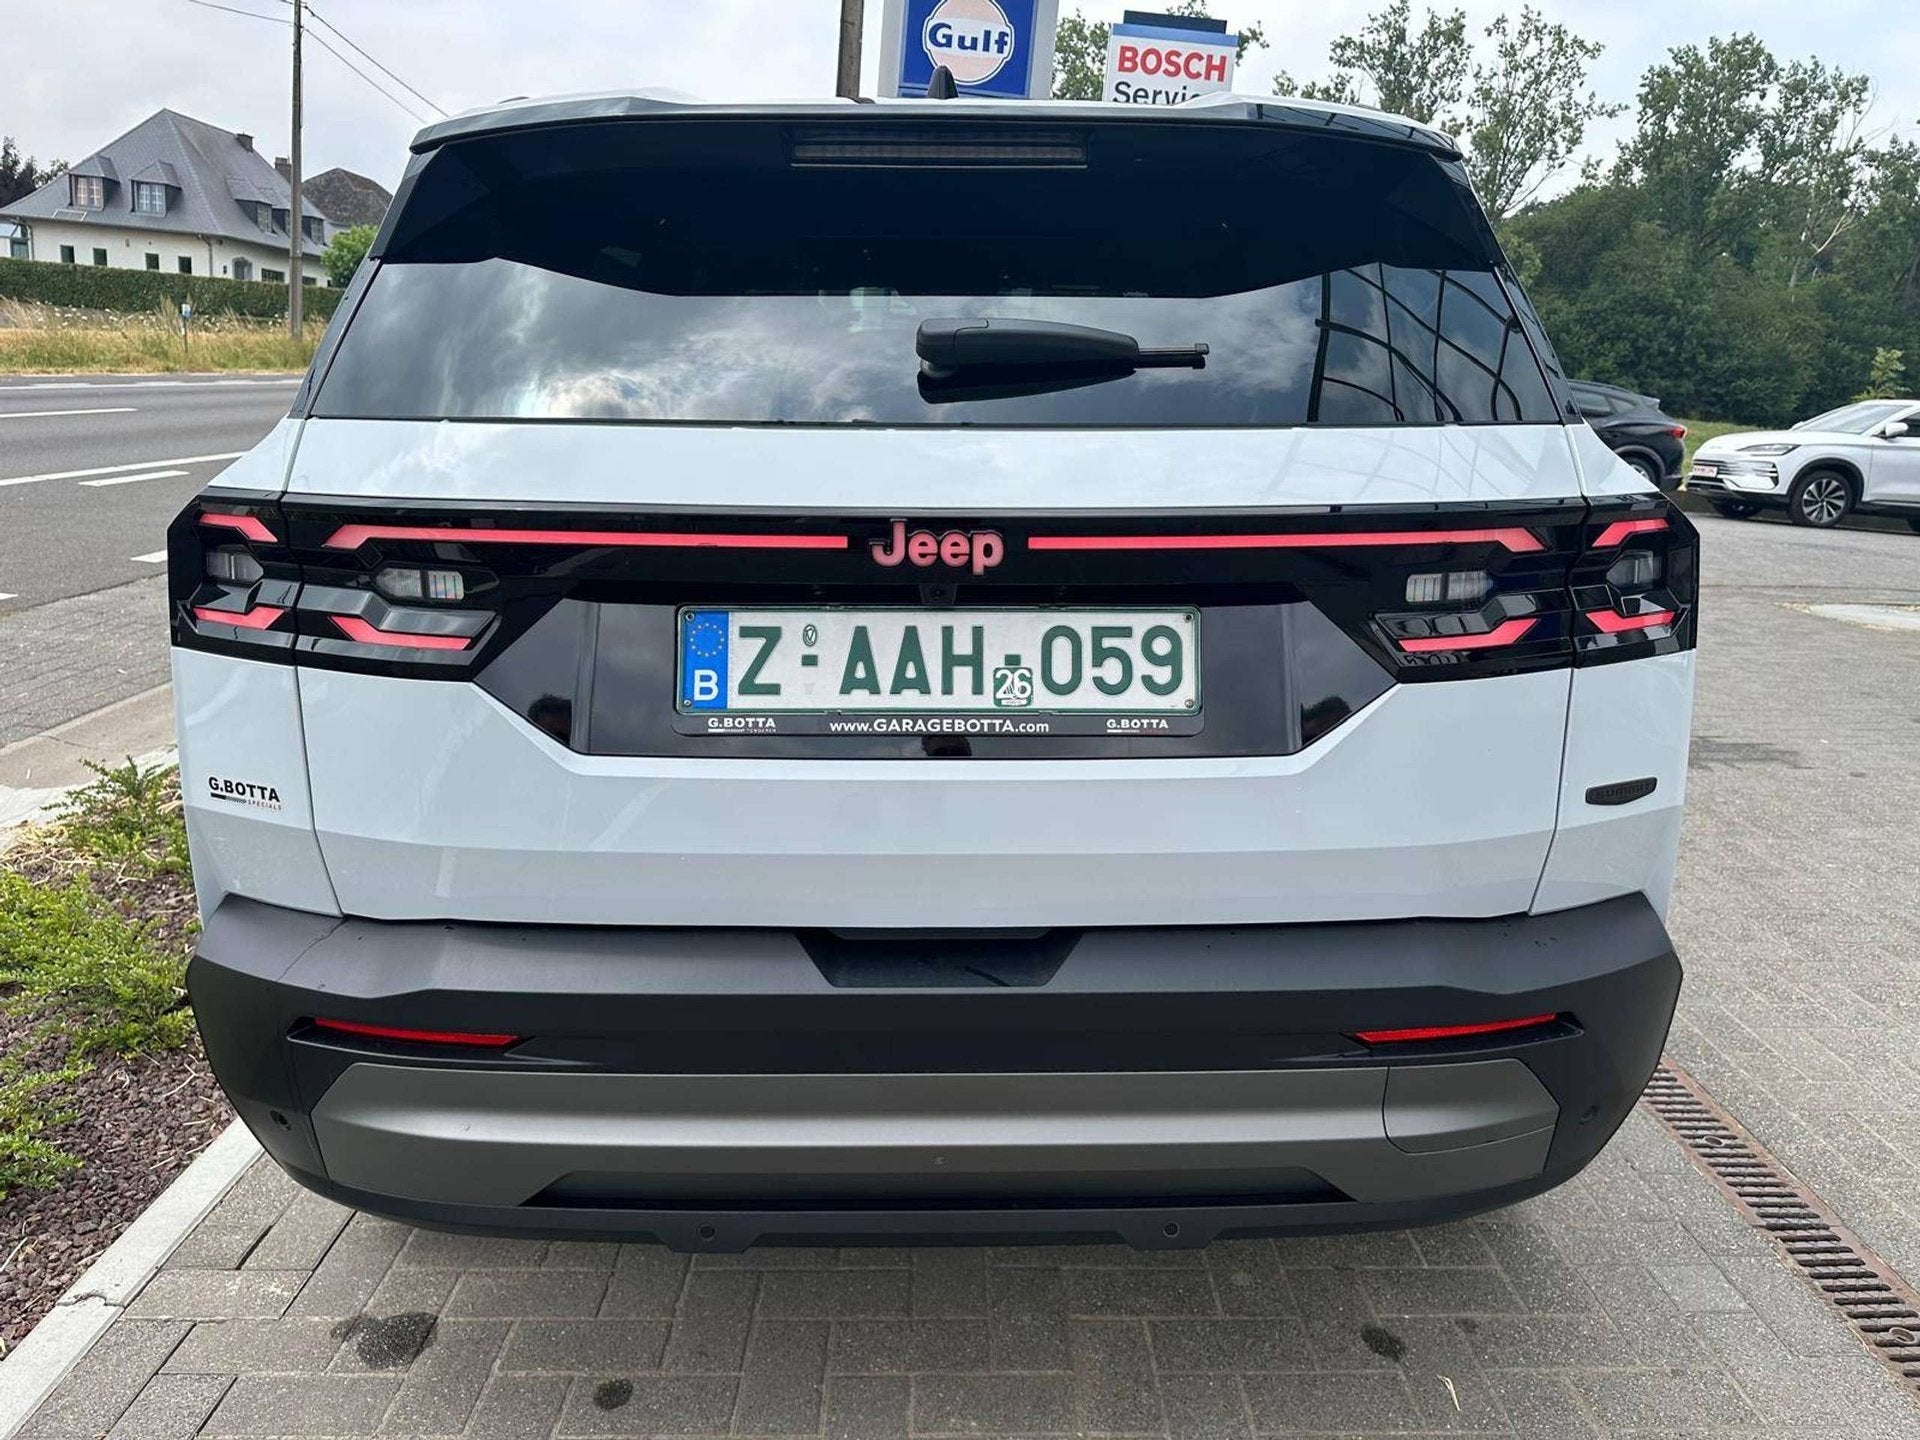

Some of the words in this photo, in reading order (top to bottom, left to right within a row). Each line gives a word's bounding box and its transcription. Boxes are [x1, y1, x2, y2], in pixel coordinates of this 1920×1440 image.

[927, 23, 1009, 55] Gulf
[1117, 45, 1228, 82] BOSCH
[1112, 81, 1201, 105] Servi
[869, 518, 1005, 576] Jeep
[693, 670, 718, 701] B
[995, 669, 1032, 699] 26
[707, 717, 776, 728] G.BOTTA
[829, 718, 1050, 733] www.GARAGEBOTTA.com
[1106, 718, 1169, 729] G.BOTTA
[208, 776, 281, 803] G.BOTTA
